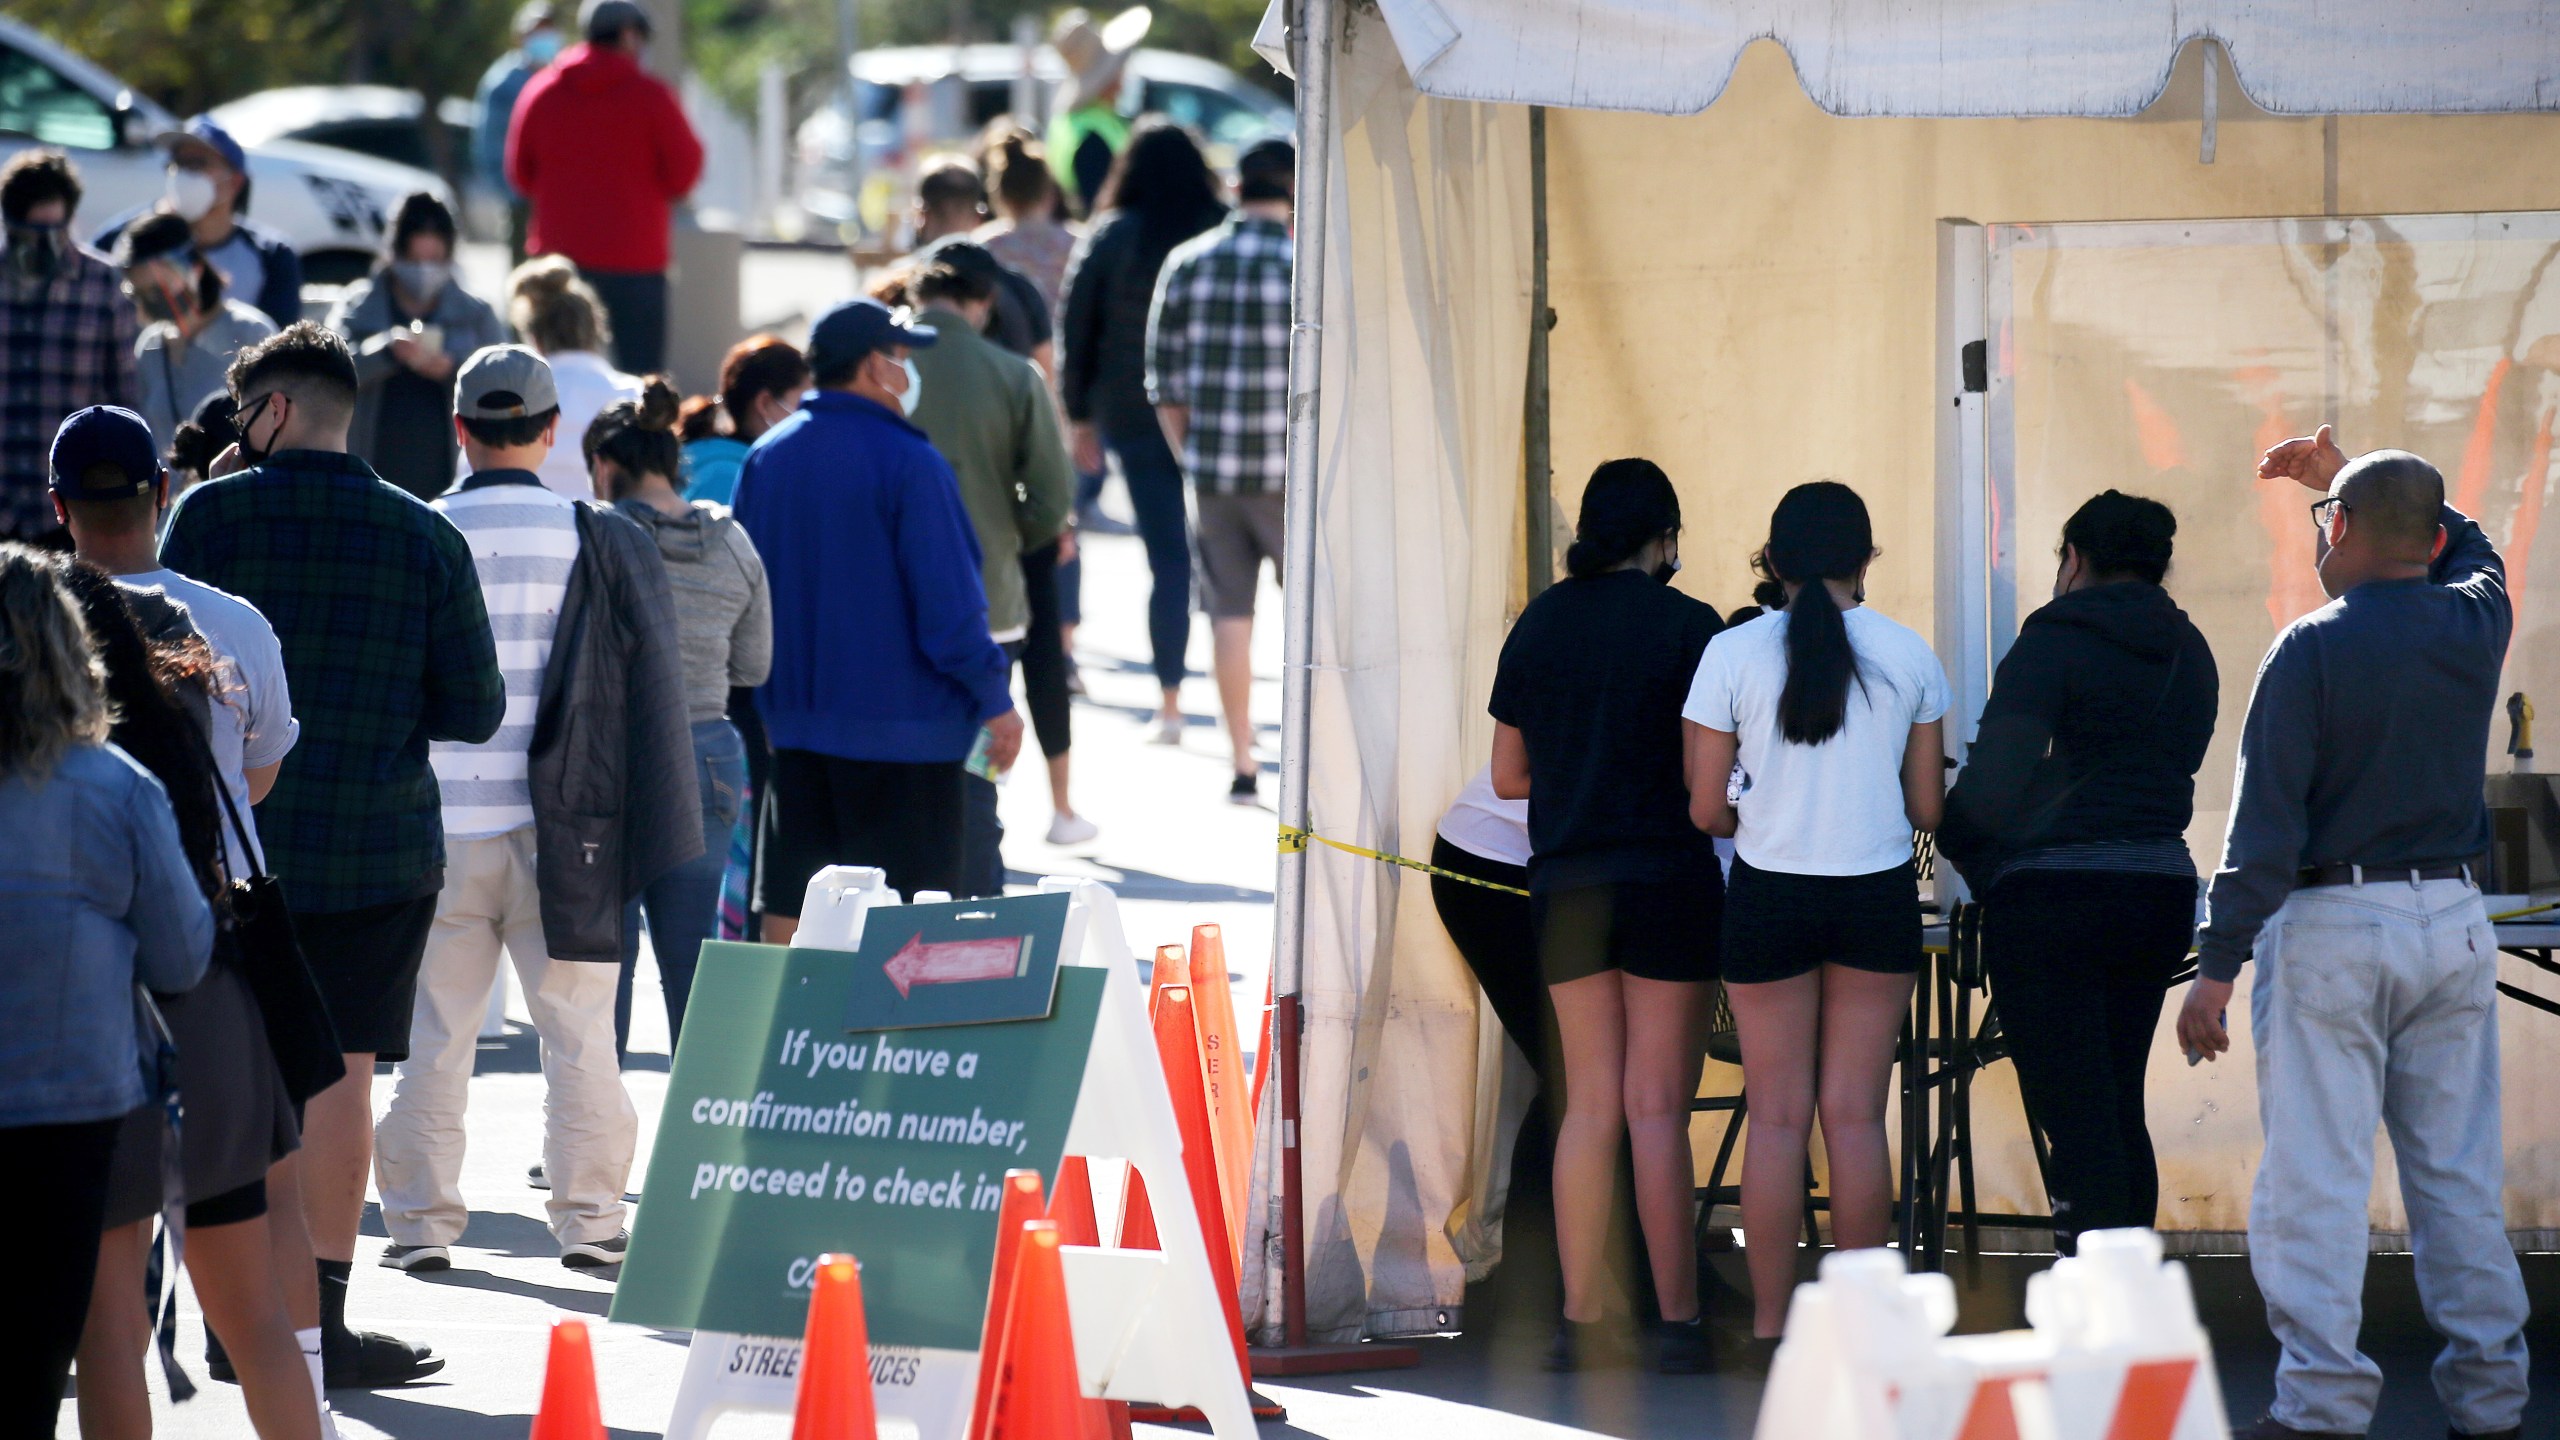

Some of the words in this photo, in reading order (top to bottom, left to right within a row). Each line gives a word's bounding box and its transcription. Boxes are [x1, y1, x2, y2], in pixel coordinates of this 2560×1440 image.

[779, 1028, 811, 1066] If
[807, 1042, 868, 1079] you
[872, 1035, 950, 1078] have
[956, 1052, 979, 1079] a
[691, 1090, 892, 1139] confirmation
[897, 1106, 1028, 1156] number,
[690, 1160, 832, 1200] proceed
[834, 1165, 866, 1202] to
[873, 1166, 967, 1209] check
[970, 1172, 1001, 1212] in
[729, 1344, 800, 1378] STREE
